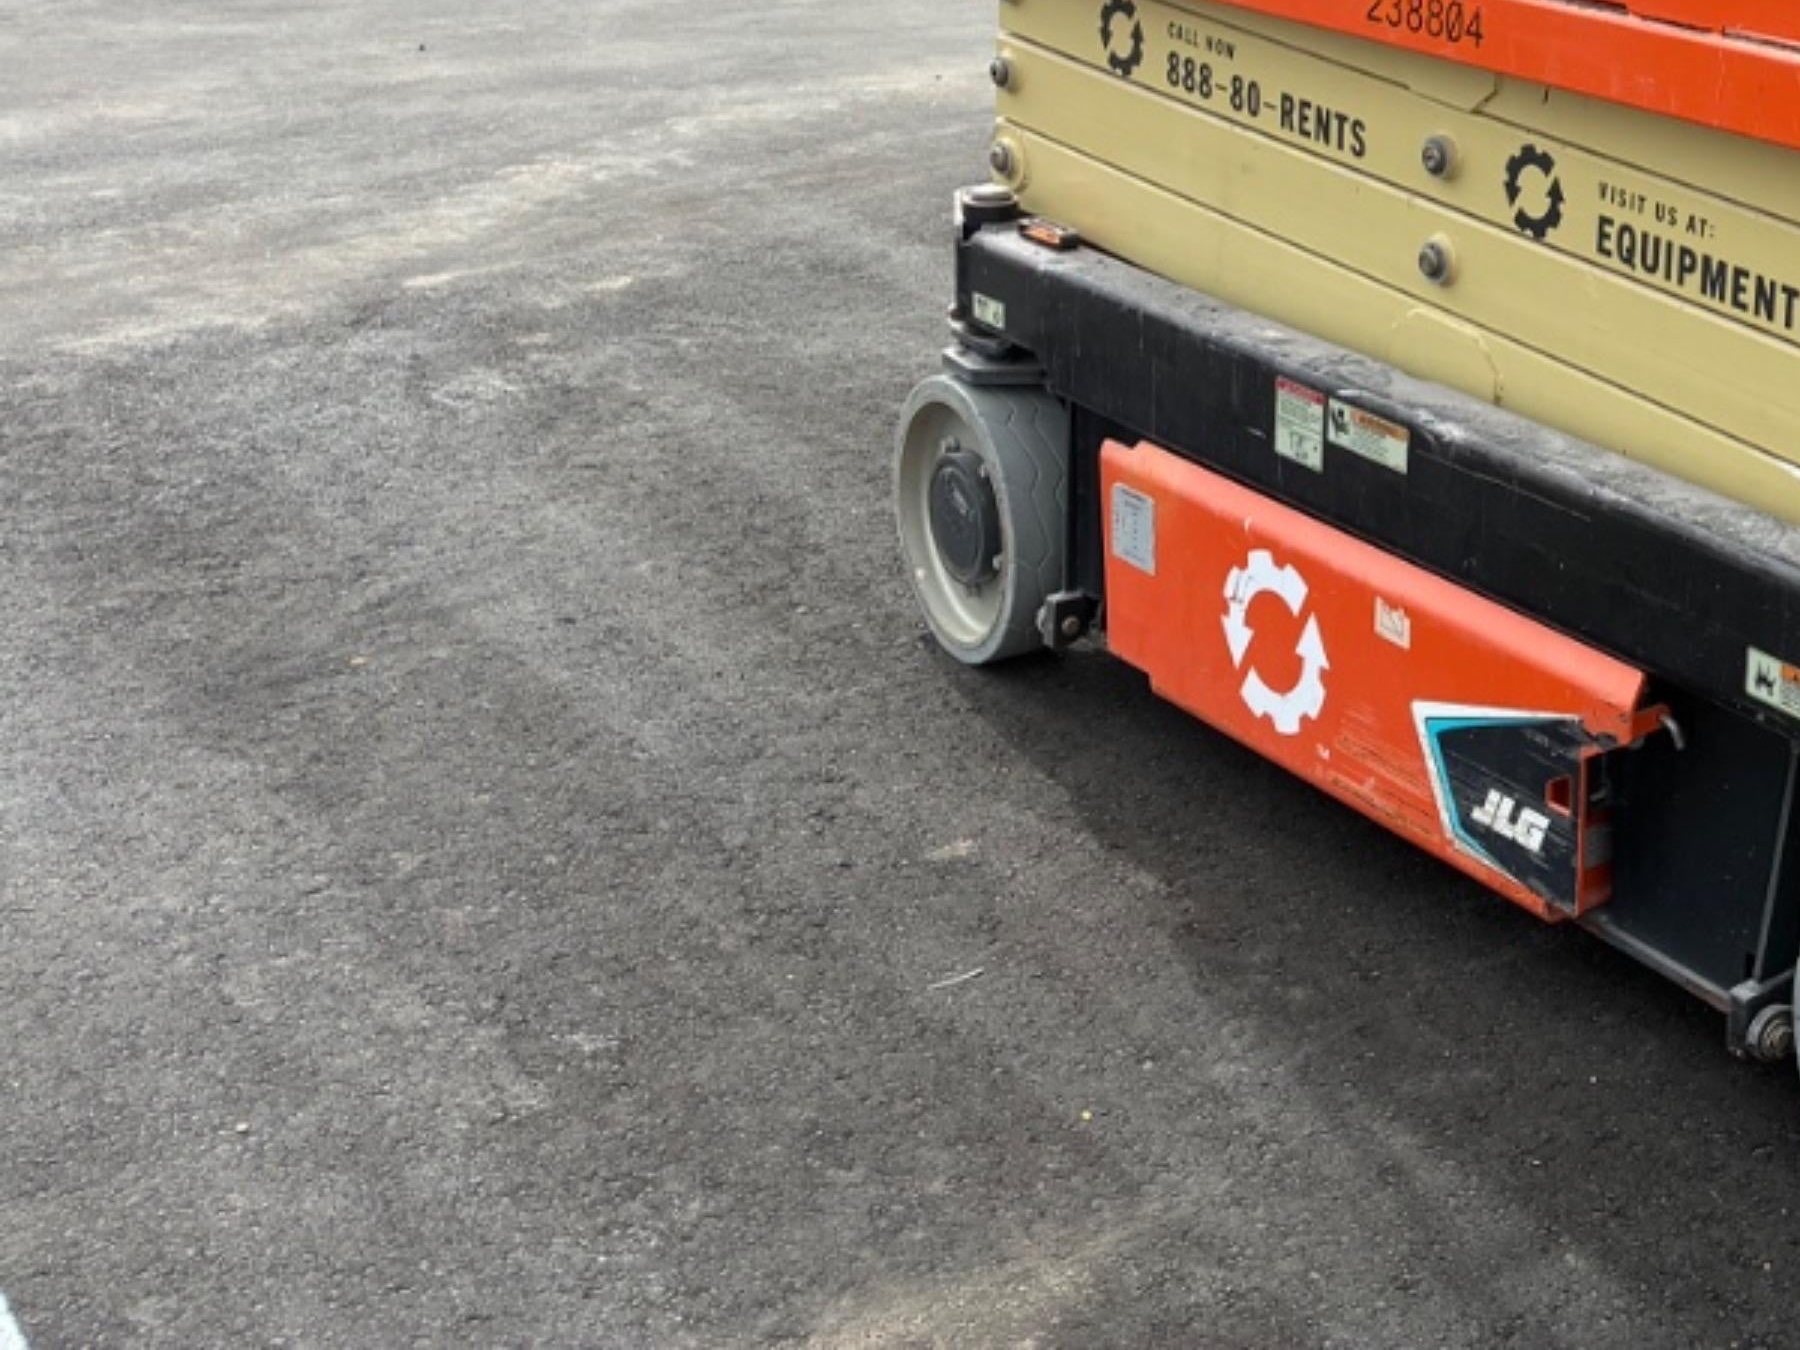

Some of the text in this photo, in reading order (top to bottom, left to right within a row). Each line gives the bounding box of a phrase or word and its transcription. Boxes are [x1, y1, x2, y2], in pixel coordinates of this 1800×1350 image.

[1167, 21, 1236, 60] CALL NOW
[1167, 52, 1366, 157] 888-80-RENTS
[1598, 182, 1716, 239] VISIT US AT:
[1471, 789, 1550, 852] JLG
